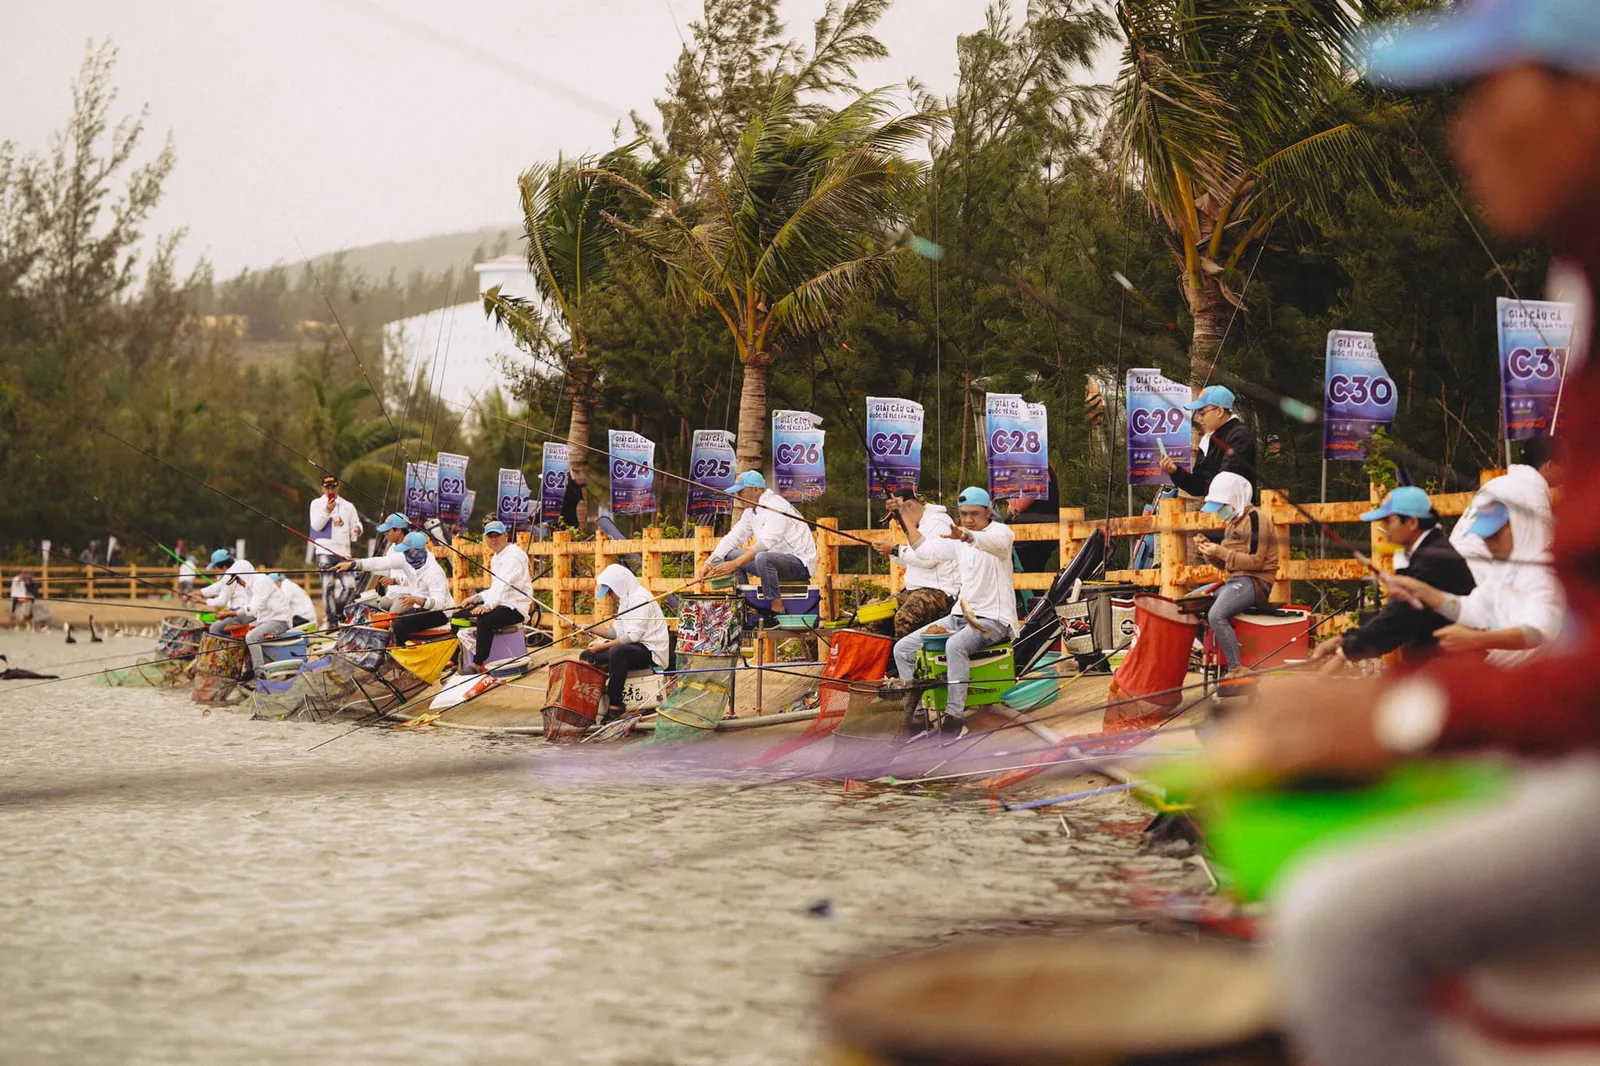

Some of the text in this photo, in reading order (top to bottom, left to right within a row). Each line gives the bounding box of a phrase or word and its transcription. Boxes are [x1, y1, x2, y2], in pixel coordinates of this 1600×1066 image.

[1329, 374, 1393, 405] C30
[1133, 408, 1185, 434] C29
[872, 432, 916, 456] C27
[992, 429, 1041, 454] C28
[777, 443, 820, 465] C26
[613, 460, 649, 479] C24
[694, 458, 731, 478] C25
[441, 478, 464, 494] C21
[545, 471, 569, 489] C2
